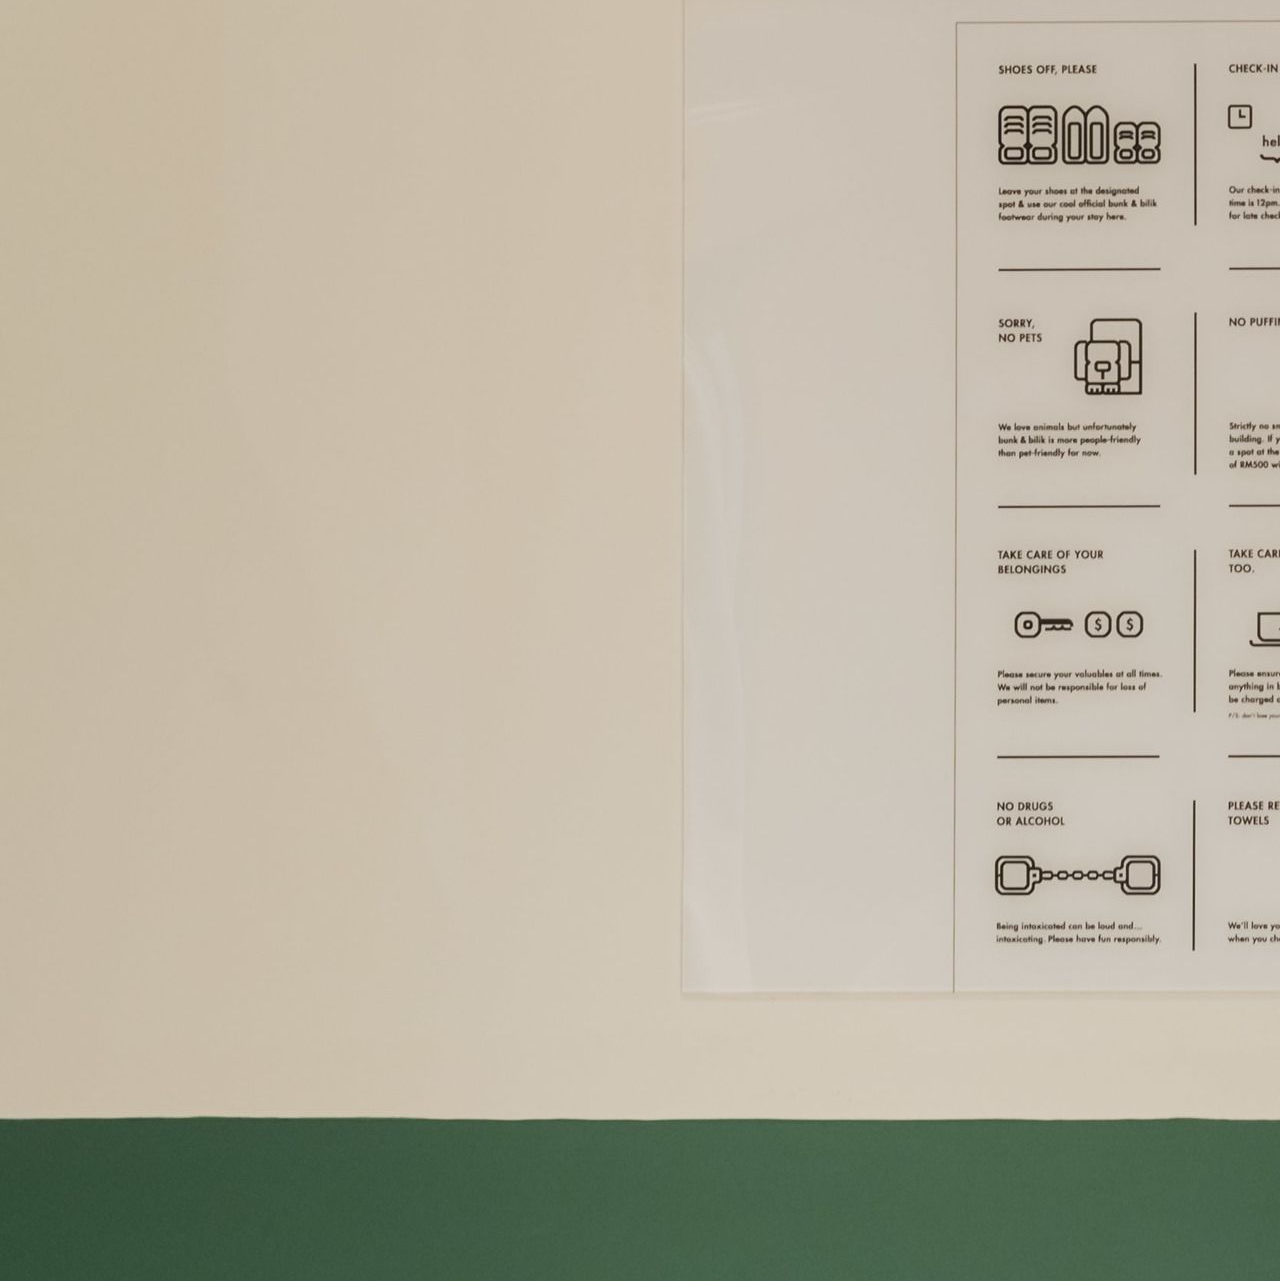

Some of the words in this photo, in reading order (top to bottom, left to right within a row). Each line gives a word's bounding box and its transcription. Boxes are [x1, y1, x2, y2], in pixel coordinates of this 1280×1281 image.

[999, 65, 1032, 74] SHOES
[1036, 65, 1057, 75] OFF,
[1062, 64, 1097, 74] PLEASE
[1229, 63, 1278, 73] CHECK-IN
[999, 187, 1021, 195] Leave
[1024, 189, 1042, 197] your
[1045, 186, 1067, 195] shoes
[1080, 186, 1093, 195] the
[1095, 186, 1139, 197] designated
[1229, 186, 1245, 194] Our
[999, 318, 1034, 329] SORRY,
[1229, 317, 1246, 326] NO
[999, 333, 1016, 342] NO
[1019, 333, 1042, 342] PETS
[998, 423, 1011, 431] We
[1014, 422, 1031, 431] love
[1033, 422, 1064, 431] animals
[1067, 422, 1080, 431] but
[1083, 422, 1136, 433] unfortunately
[1229, 422, 1256, 432] Strictly
[998, 550, 1022, 560] TAKE
[1026, 550, 1052, 560] CARE
[1056, 550, 1070, 559] OF
[1074, 550, 1103, 559] YOUR
[1228, 549, 1253, 558] TAKE
[998, 564, 1066, 574] BELONGINGS
[1229, 563, 1254, 573] TOO.
[998, 670, 1023, 678] Please
[1054, 672, 1072, 680] your
[1075, 669, 1113, 678] valuables
[1126, 669, 1136, 678] all
[1229, 668, 1254, 677] Please
[997, 695, 1032, 706] personal
[997, 802, 1014, 811] NO
[1018, 801, 1053, 811] DRUGS
[1228, 801, 1264, 811] PLEASE
[996, 816, 1012, 826] OR
[1015, 816, 1065, 826] ALCOHOL
[1228, 816, 1269, 825] TOWELS
[996, 922, 1019, 932] Being
[1021, 921, 1066, 930] intoxicated
[1085, 921, 1095, 930] be
[1098, 921, 1115, 930] loud
[1251, 921, 1268, 930] love
